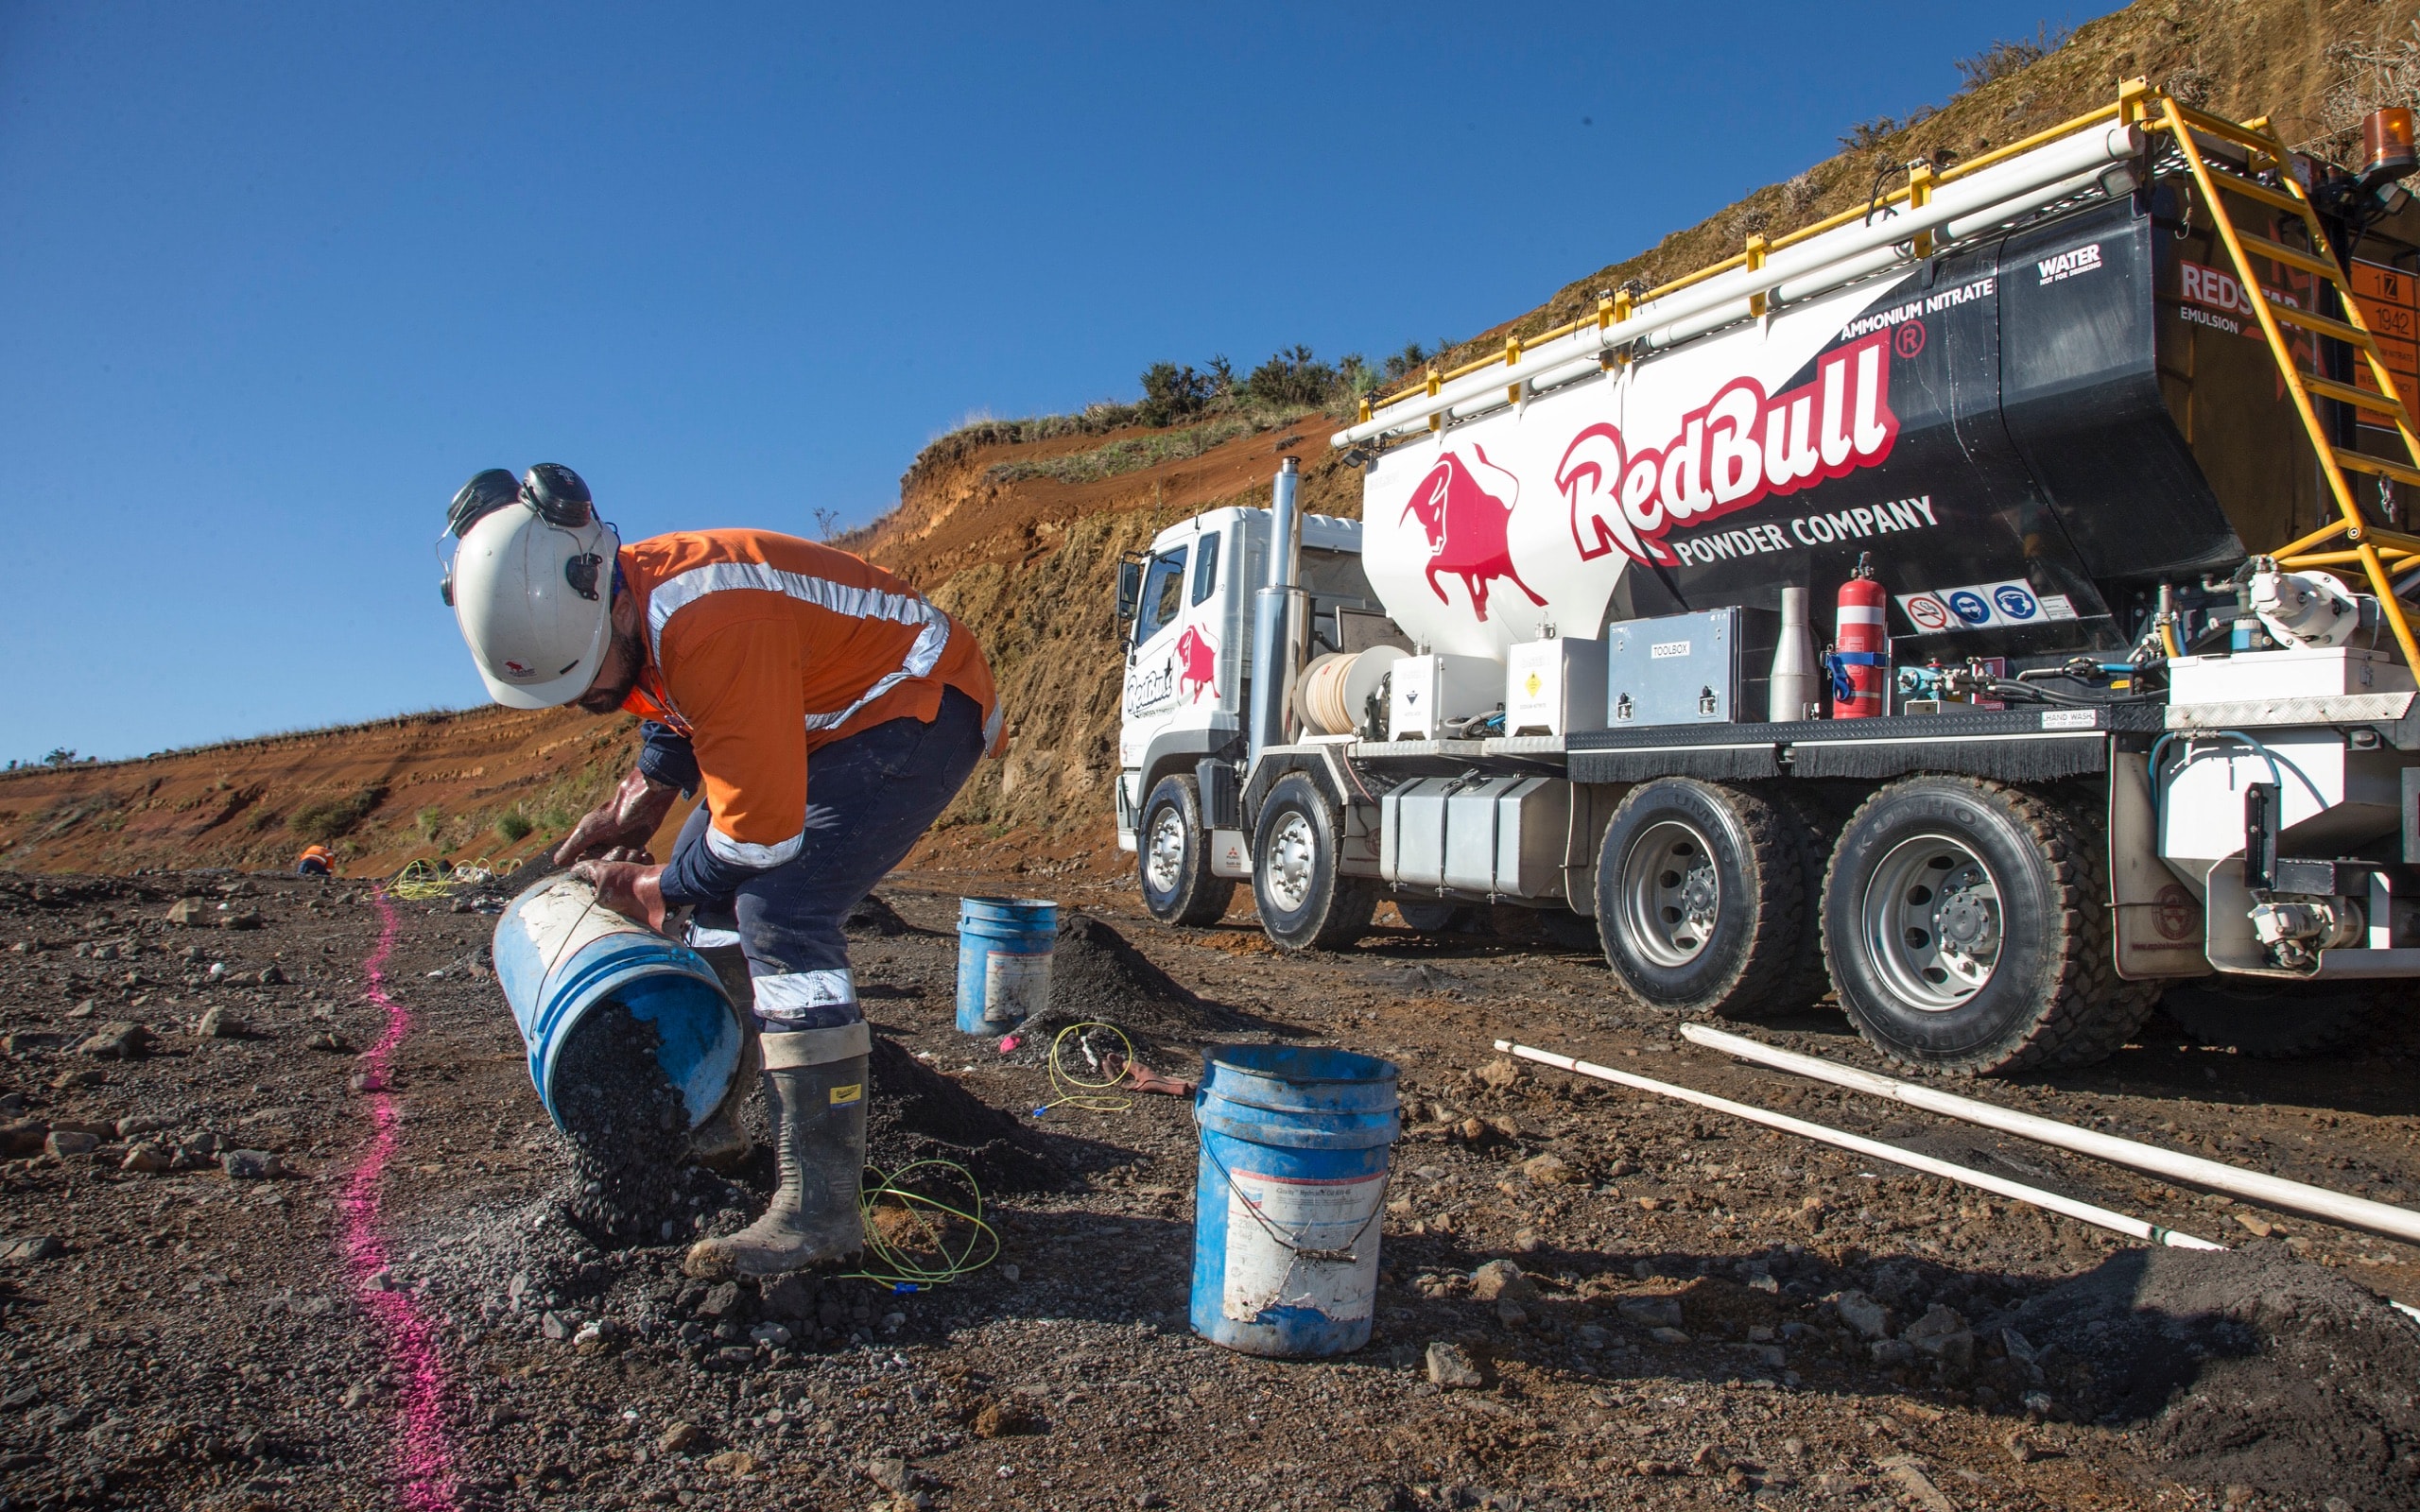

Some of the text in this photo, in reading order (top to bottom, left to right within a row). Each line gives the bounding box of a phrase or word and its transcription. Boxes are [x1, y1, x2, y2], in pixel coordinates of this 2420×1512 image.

[2037, 244, 2100, 278] WATER
[2039, 276, 2053, 286] NOT
[2055, 272, 2068, 282] FOR
[1841, 278, 1994, 341] AMMONIUM NITRATE
[2182, 264, 2301, 331] REDS
[2180, 305, 2238, 335] EMULSION
[2376, 307, 2410, 335] 1942
[1556, 331, 1894, 565] RedBull
[1674, 494, 1939, 567] POWDER COMPANY
[1653, 644, 1687, 656] TOOLBOX
